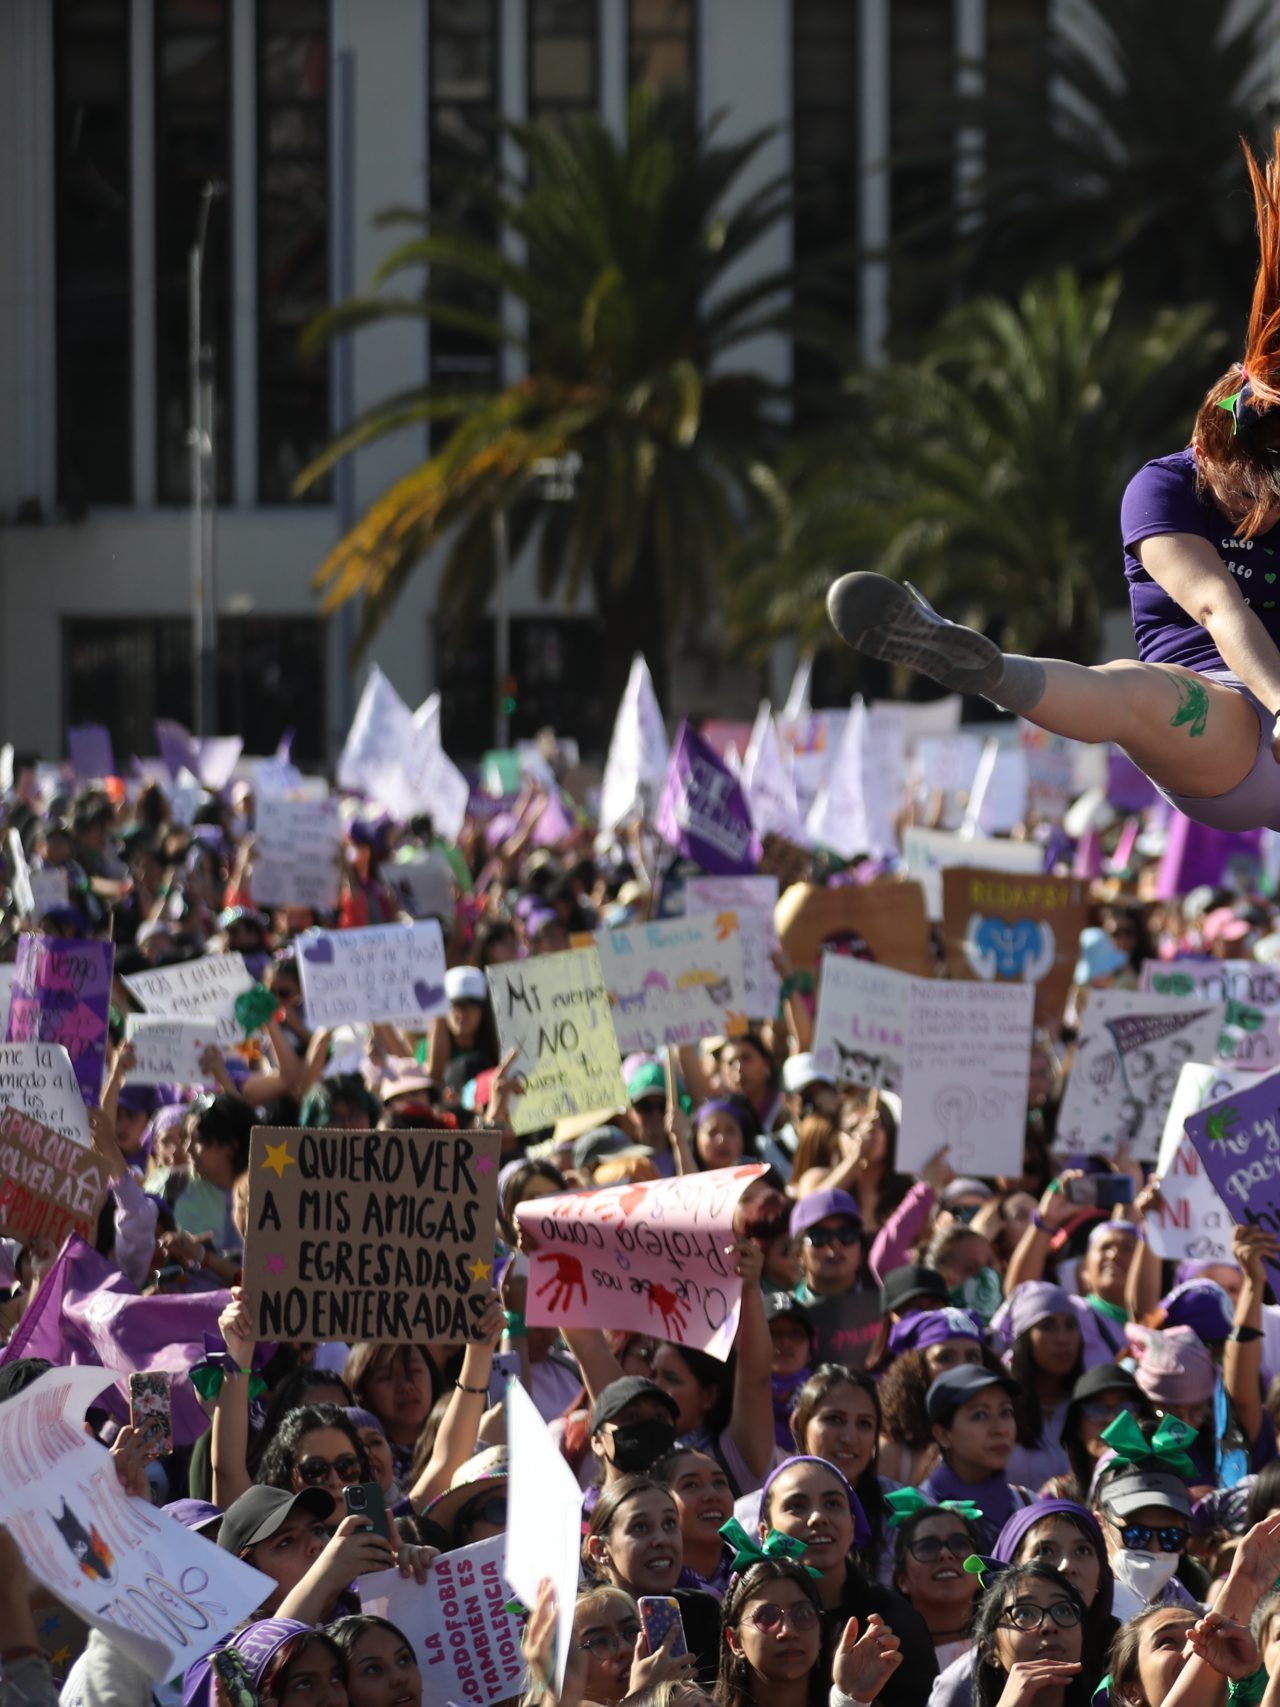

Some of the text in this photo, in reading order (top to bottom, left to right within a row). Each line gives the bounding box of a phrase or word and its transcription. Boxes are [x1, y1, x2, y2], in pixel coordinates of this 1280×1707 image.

[1225, 560, 1253, 579] REO
[36, 1045, 52, 1069] la
[537, 1019, 580, 1059] NO
[298, 1134, 478, 1196] QUIERO VER
[257, 1190, 480, 1244] A MIS AMIGAS
[541, 1216, 605, 1249] como
[298, 1240, 472, 1295] EGRESADAS
[259, 1286, 488, 1340] NO ENTERRADAS
[456, 1558, 503, 1699] TAMBIÉN ES
[480, 1560, 521, 1682] VIOLENCIA
[425, 1632, 446, 1666] LA
